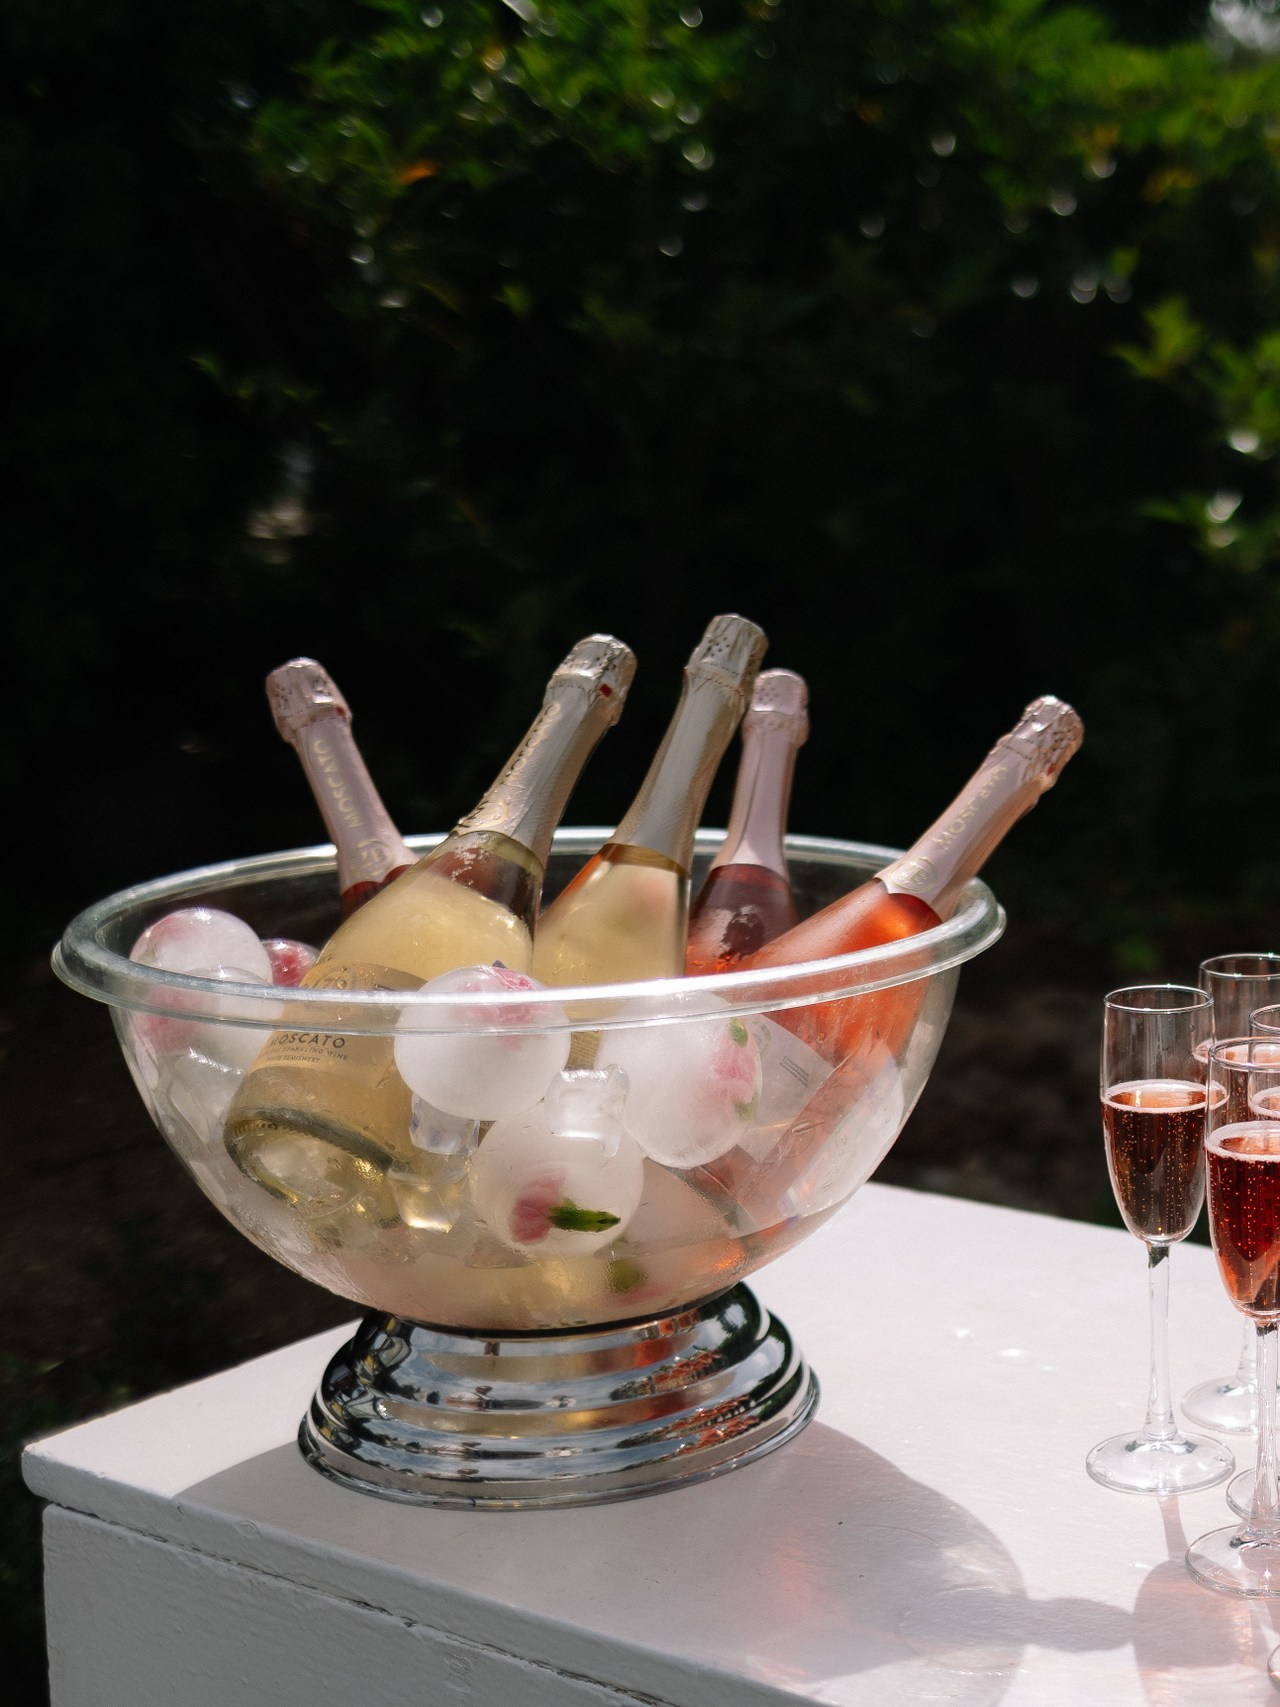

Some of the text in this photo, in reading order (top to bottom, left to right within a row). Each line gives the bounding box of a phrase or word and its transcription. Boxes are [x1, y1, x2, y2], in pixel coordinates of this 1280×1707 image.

[314, 739, 364, 829] MOSCATO
[931, 766, 1009, 851] MOSCATO
[270, 1033, 346, 1049] MOSCATO
